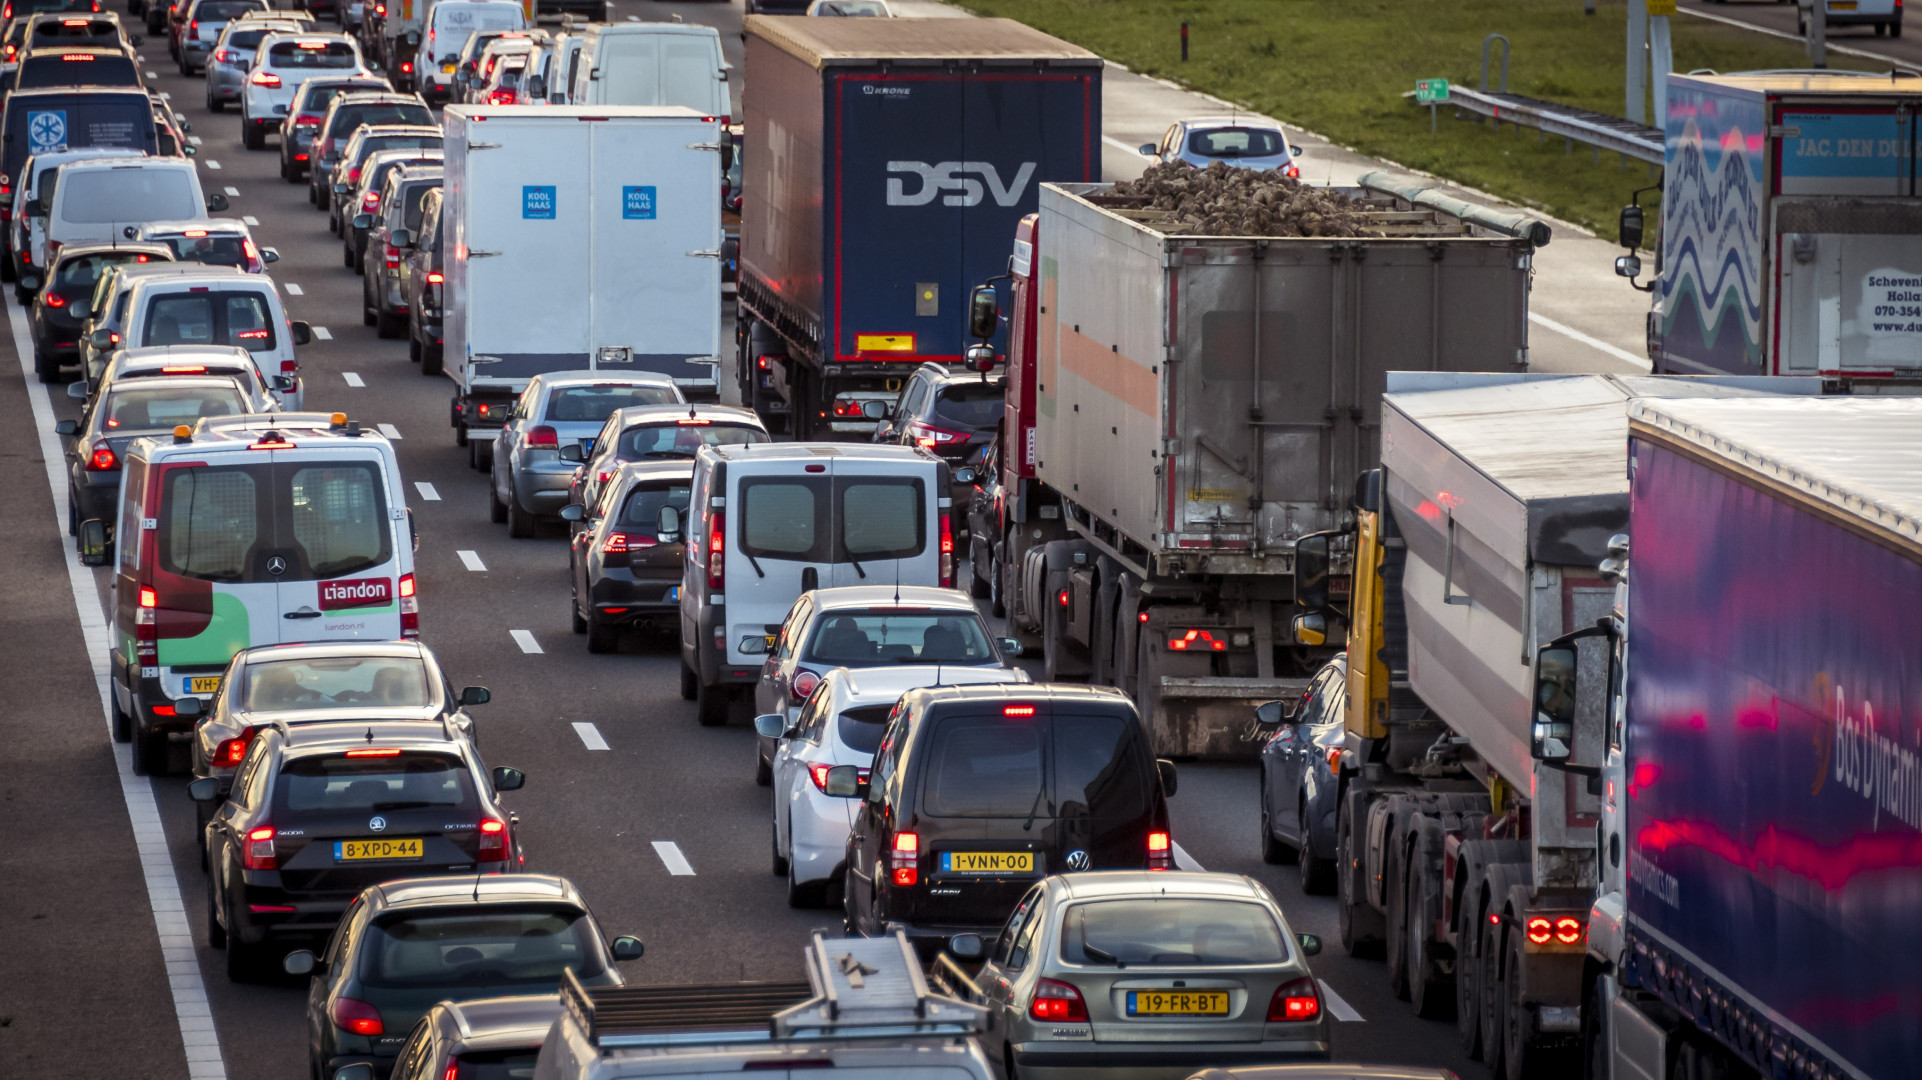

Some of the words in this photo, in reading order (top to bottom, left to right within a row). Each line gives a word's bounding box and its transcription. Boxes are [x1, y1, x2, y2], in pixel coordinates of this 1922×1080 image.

[1837, 139, 1873, 157] DEN
[886, 161, 1037, 207] DSV
[528, 192, 550, 200] KOOL
[628, 192, 650, 200] KOOL
[528, 201, 551, 209] HAAS
[628, 201, 651, 209] HAAS
[1868, 276, 1922, 287] Scheven
[1887, 291, 1922, 301] Holla
[1875, 306, 1922, 317] 070-354
[324, 582, 386, 600] Liandon
[325, 622, 366, 631] liandon.nl
[194, 679, 222, 691] VH-
[1239, 717, 1275, 742] Tra
[1835, 685, 1861, 793] Bos
[1863, 700, 1922, 834] Dynami
[346, 841, 418, 857] 8-XPD-44
[956, 855, 1027, 869] 1-VNN-00
[1145, 995, 1219, 1011] 19-FR-BT
